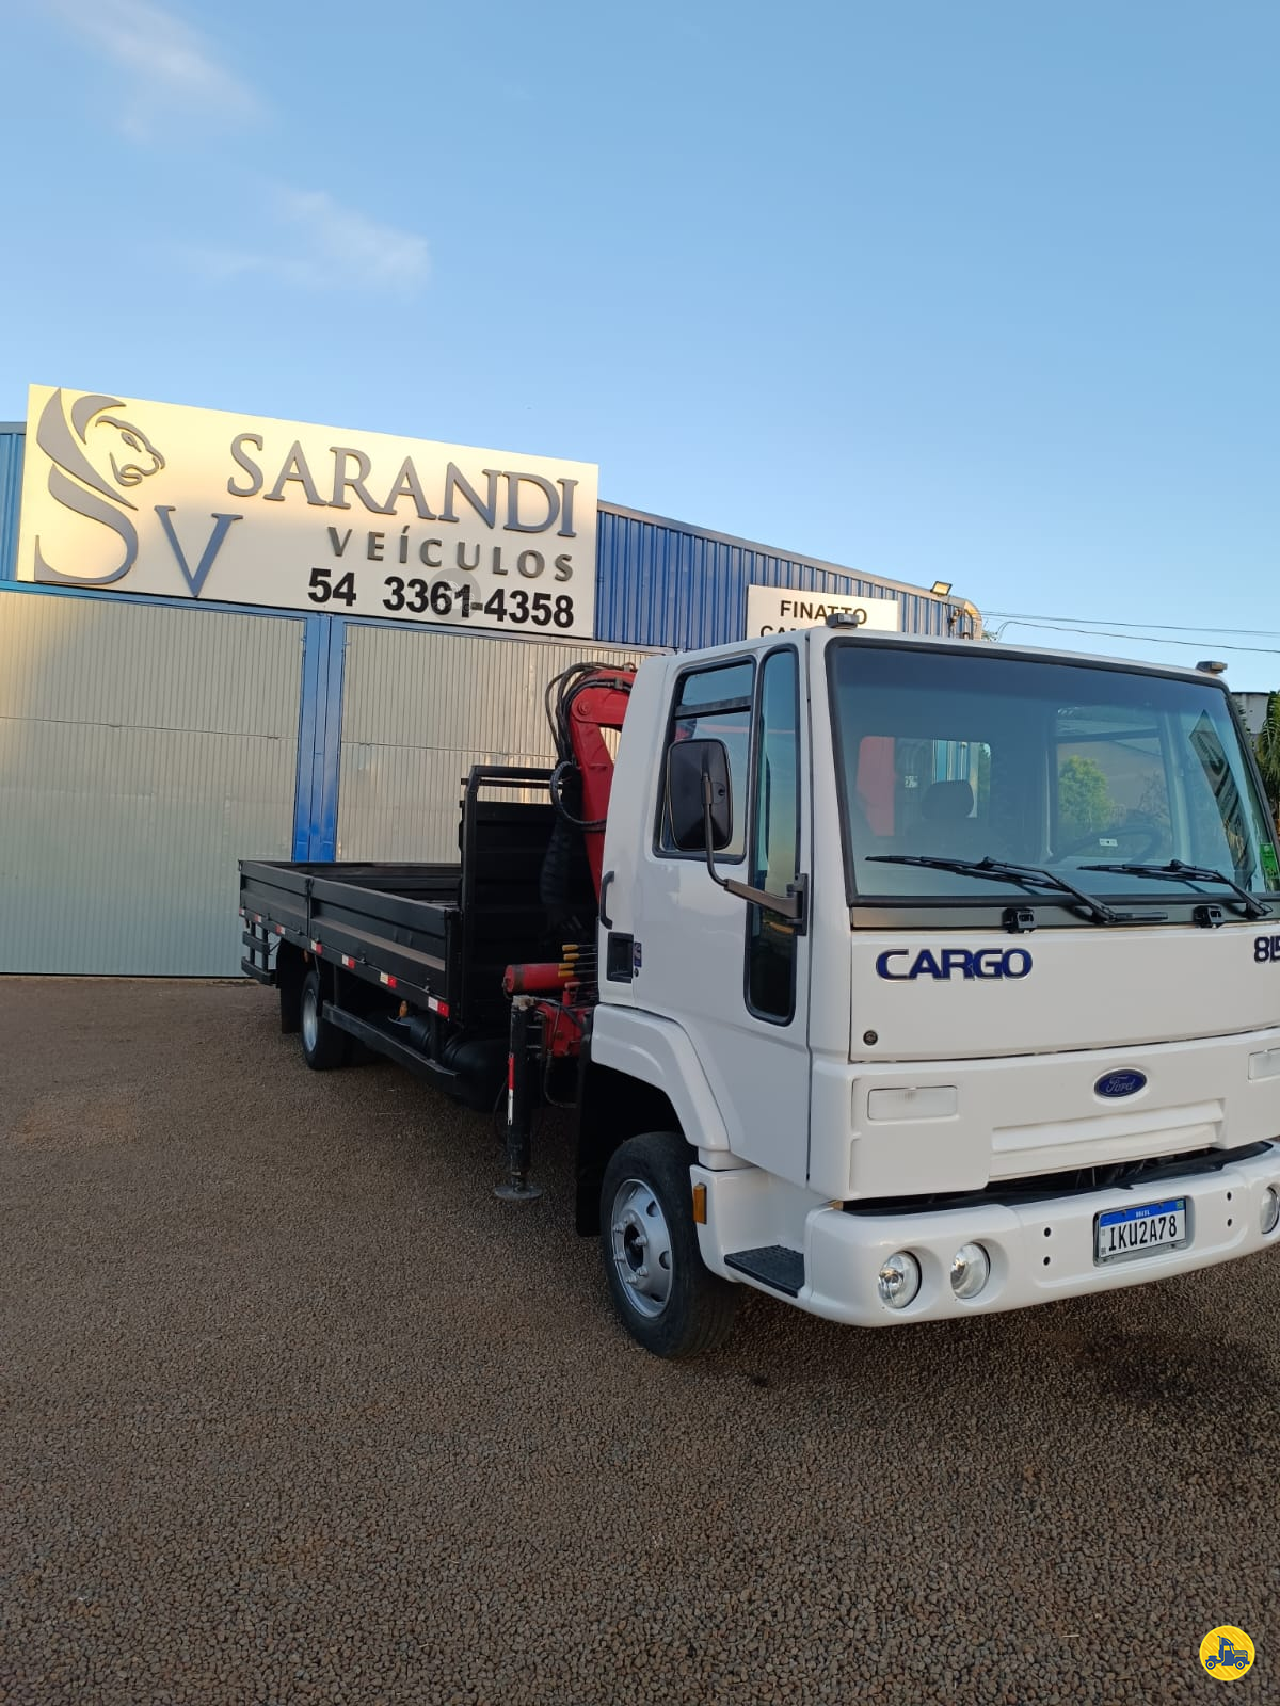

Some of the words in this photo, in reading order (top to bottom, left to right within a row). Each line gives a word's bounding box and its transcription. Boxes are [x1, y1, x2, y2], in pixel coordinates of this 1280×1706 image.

[227, 433, 578, 537] SARANDI
[327, 525, 574, 581] VEÍCULOS
[307, 567, 357, 607] 54
[383, 576, 574, 628] 3361-4358
[876, 949, 1033, 981] CARGO
[1105, 1076, 1136, 1093] Ford
[1108, 1215, 1177, 1251] IKU2A78
